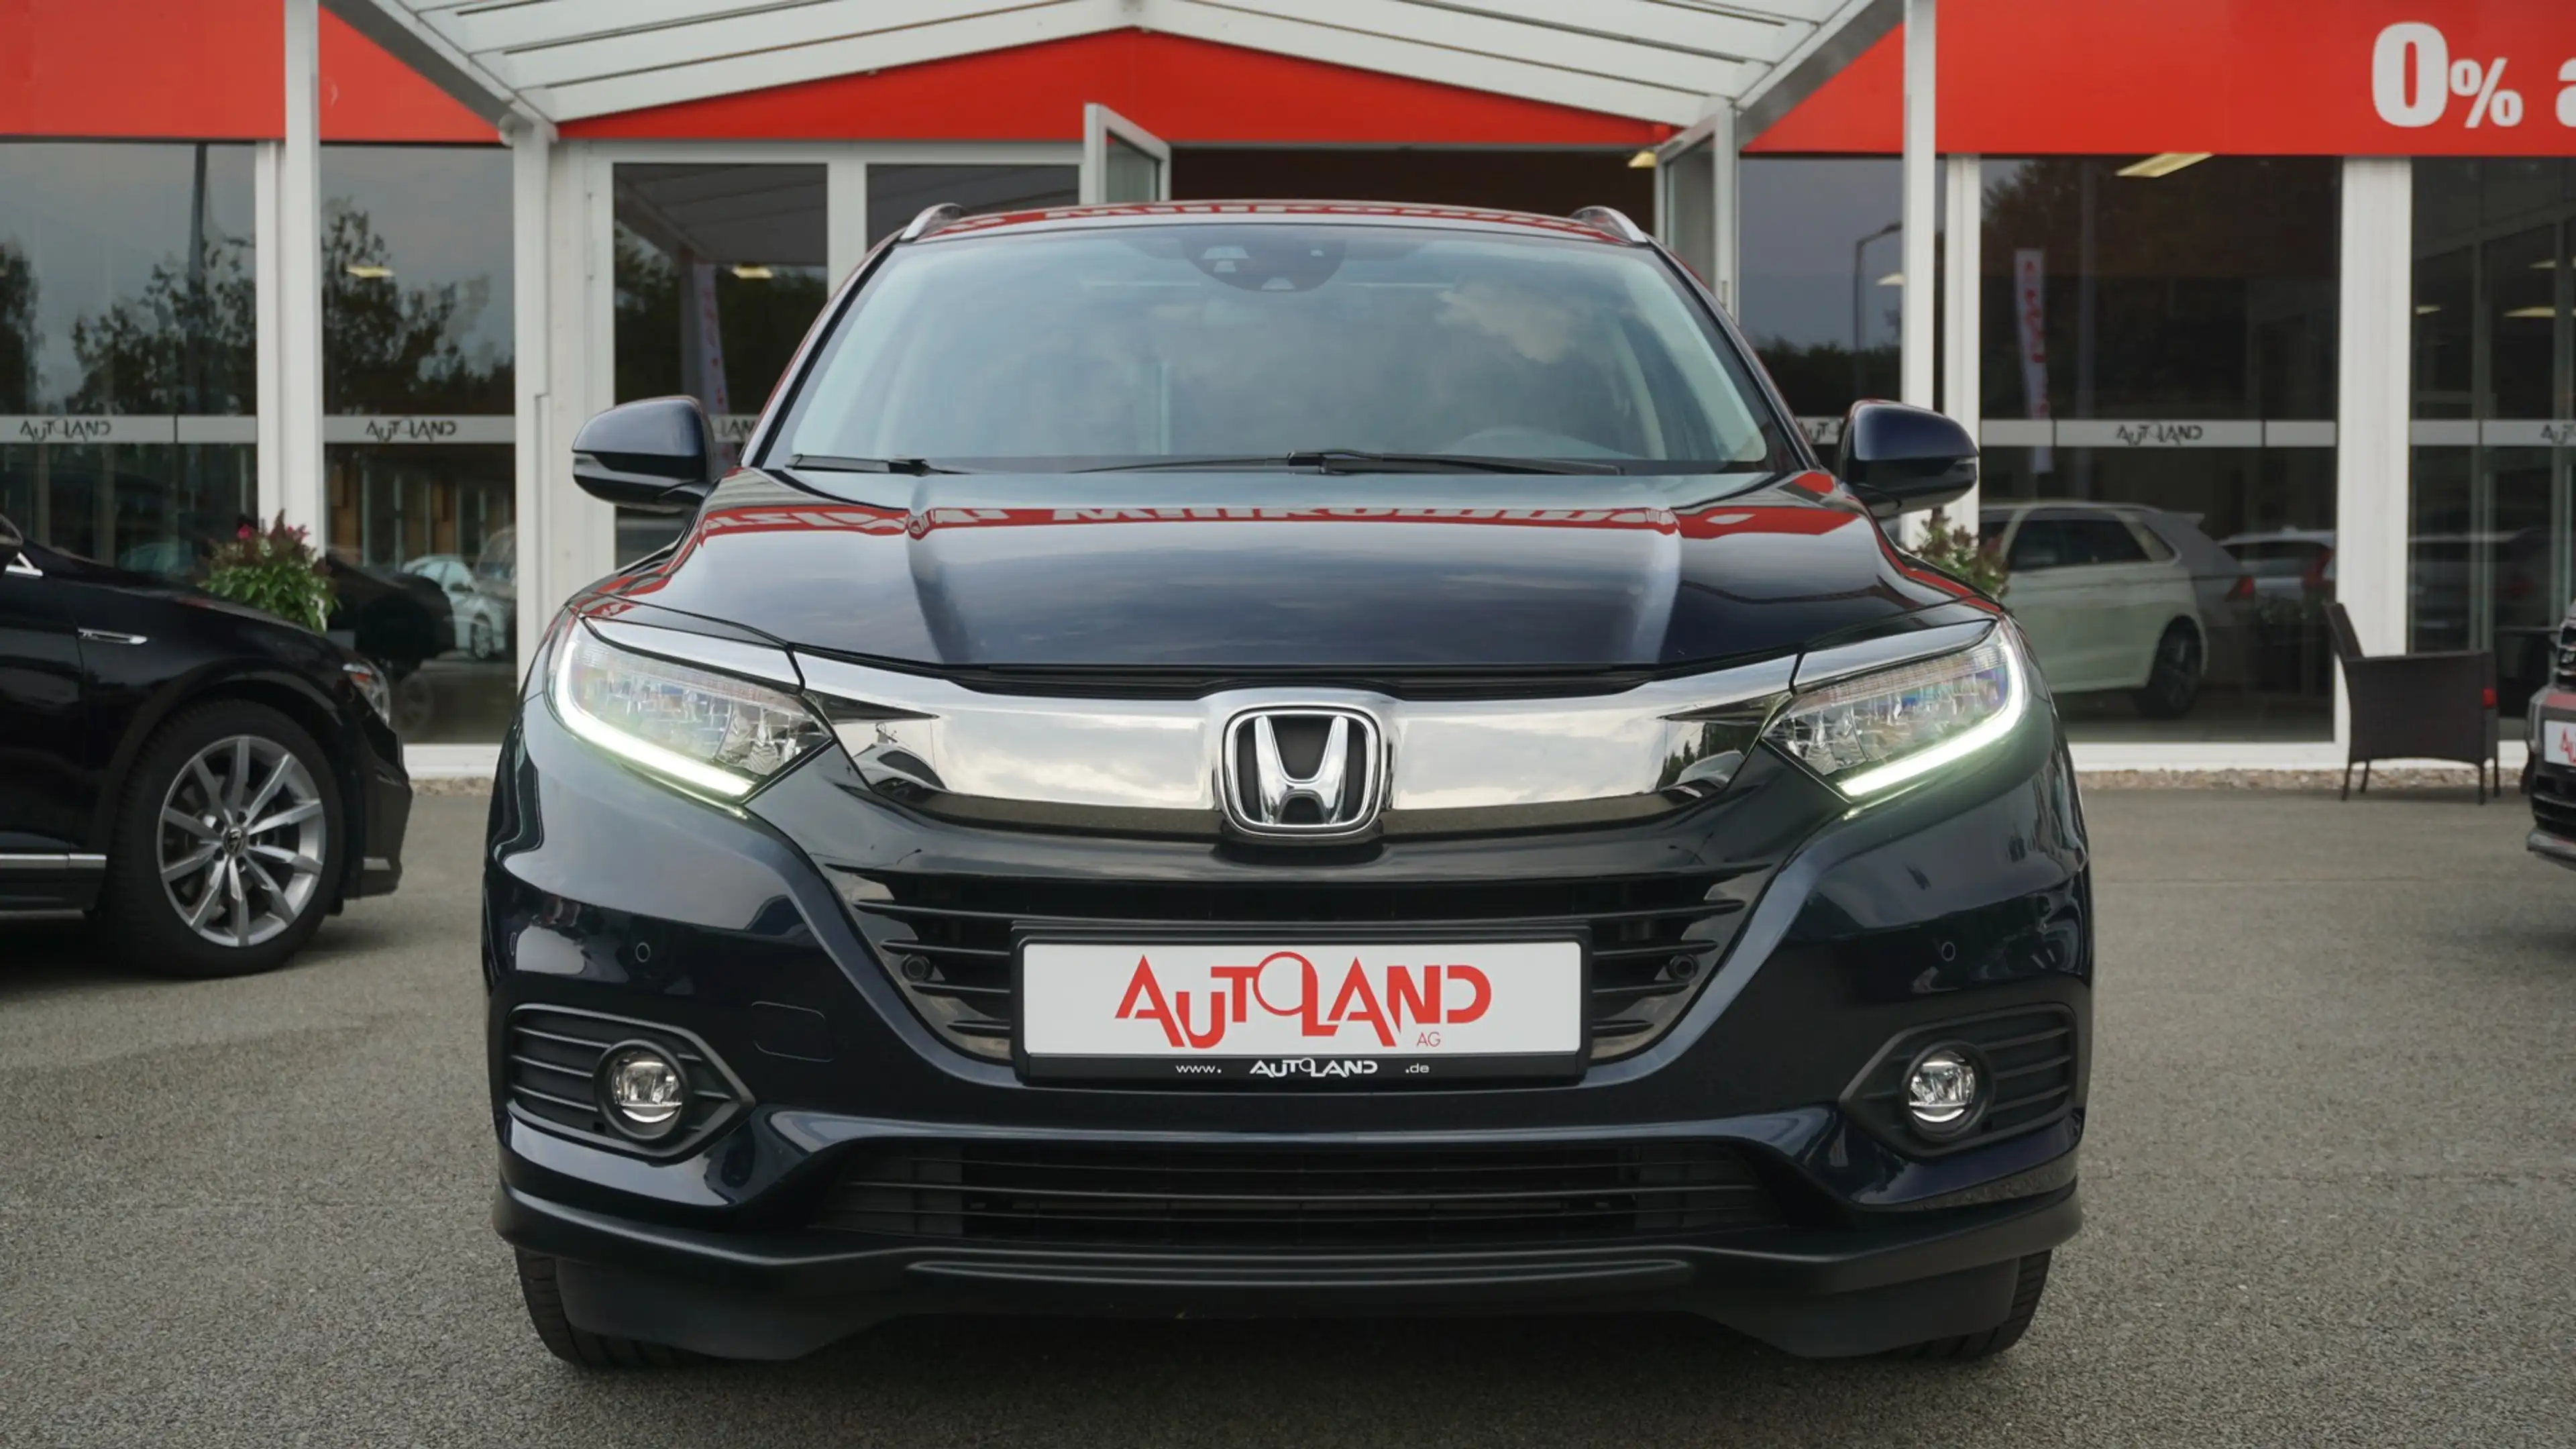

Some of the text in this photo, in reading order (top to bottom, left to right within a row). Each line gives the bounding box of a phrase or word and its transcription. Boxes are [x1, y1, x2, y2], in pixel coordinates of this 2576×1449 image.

[2372, 21, 2524, 128] 0%
[1115, 951, 1492, 1049] AUTOLAND
[1175, 1057, 1430, 1078] www. AUTOLAND .de
[1416, 1032, 1440, 1048] AG
